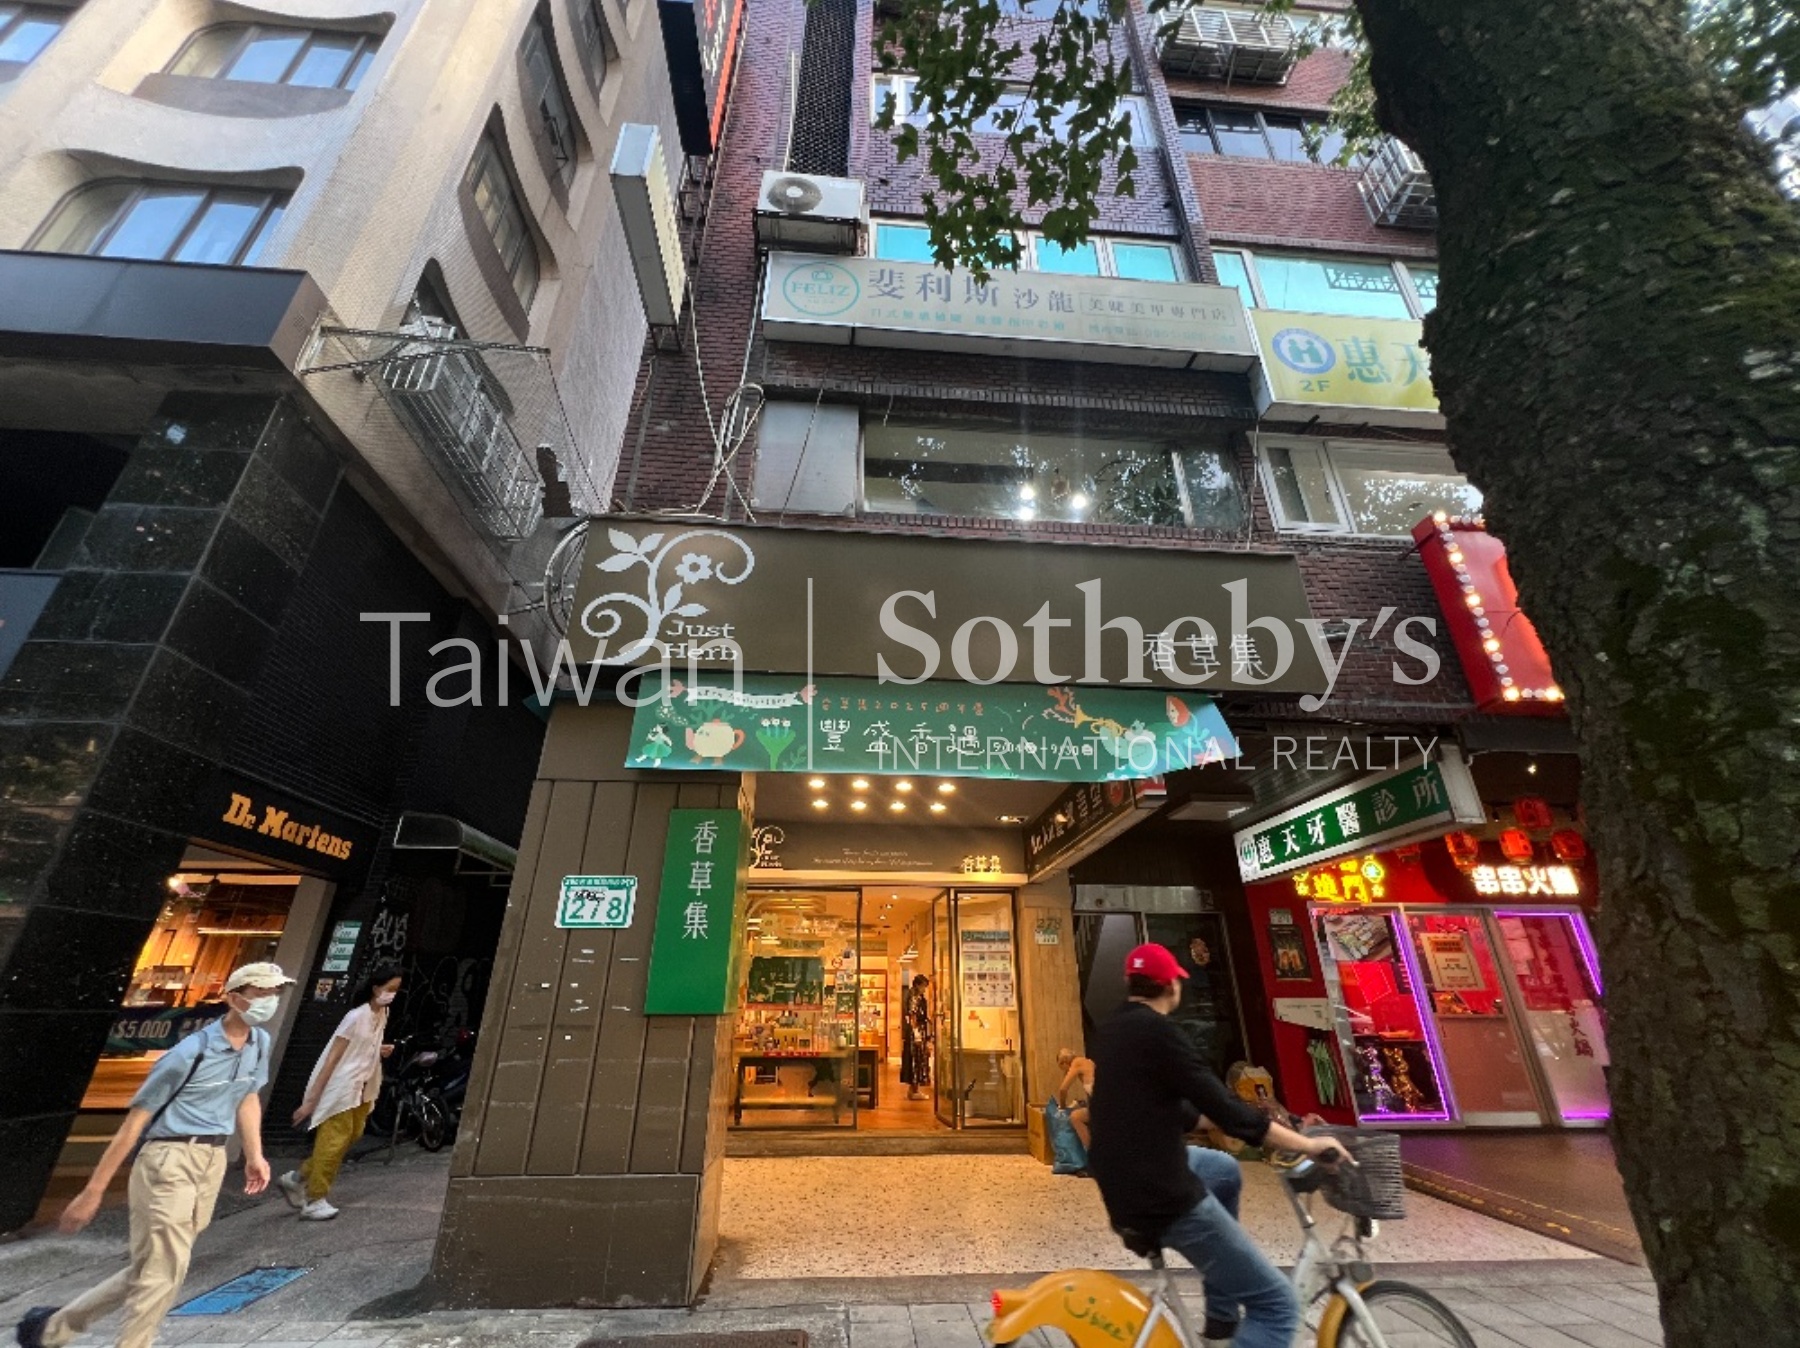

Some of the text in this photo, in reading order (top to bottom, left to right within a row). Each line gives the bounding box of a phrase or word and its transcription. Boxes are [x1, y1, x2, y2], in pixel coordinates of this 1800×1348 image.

[791, 281, 849, 297] FELIZ
[1013, 288, 1076, 314] 沙龍
[1299, 380, 1331, 392] 2F
[665, 620, 735, 639] Just
[664, 642, 739, 661] Herb
[1142, 632, 1269, 678] 香草集
[1257, 770, 1442, 865] 惠天牙醫診所
[257, 805, 354, 860] Martens
[681, 820, 719, 940] 香草集
[568, 896, 622, 921] 278
